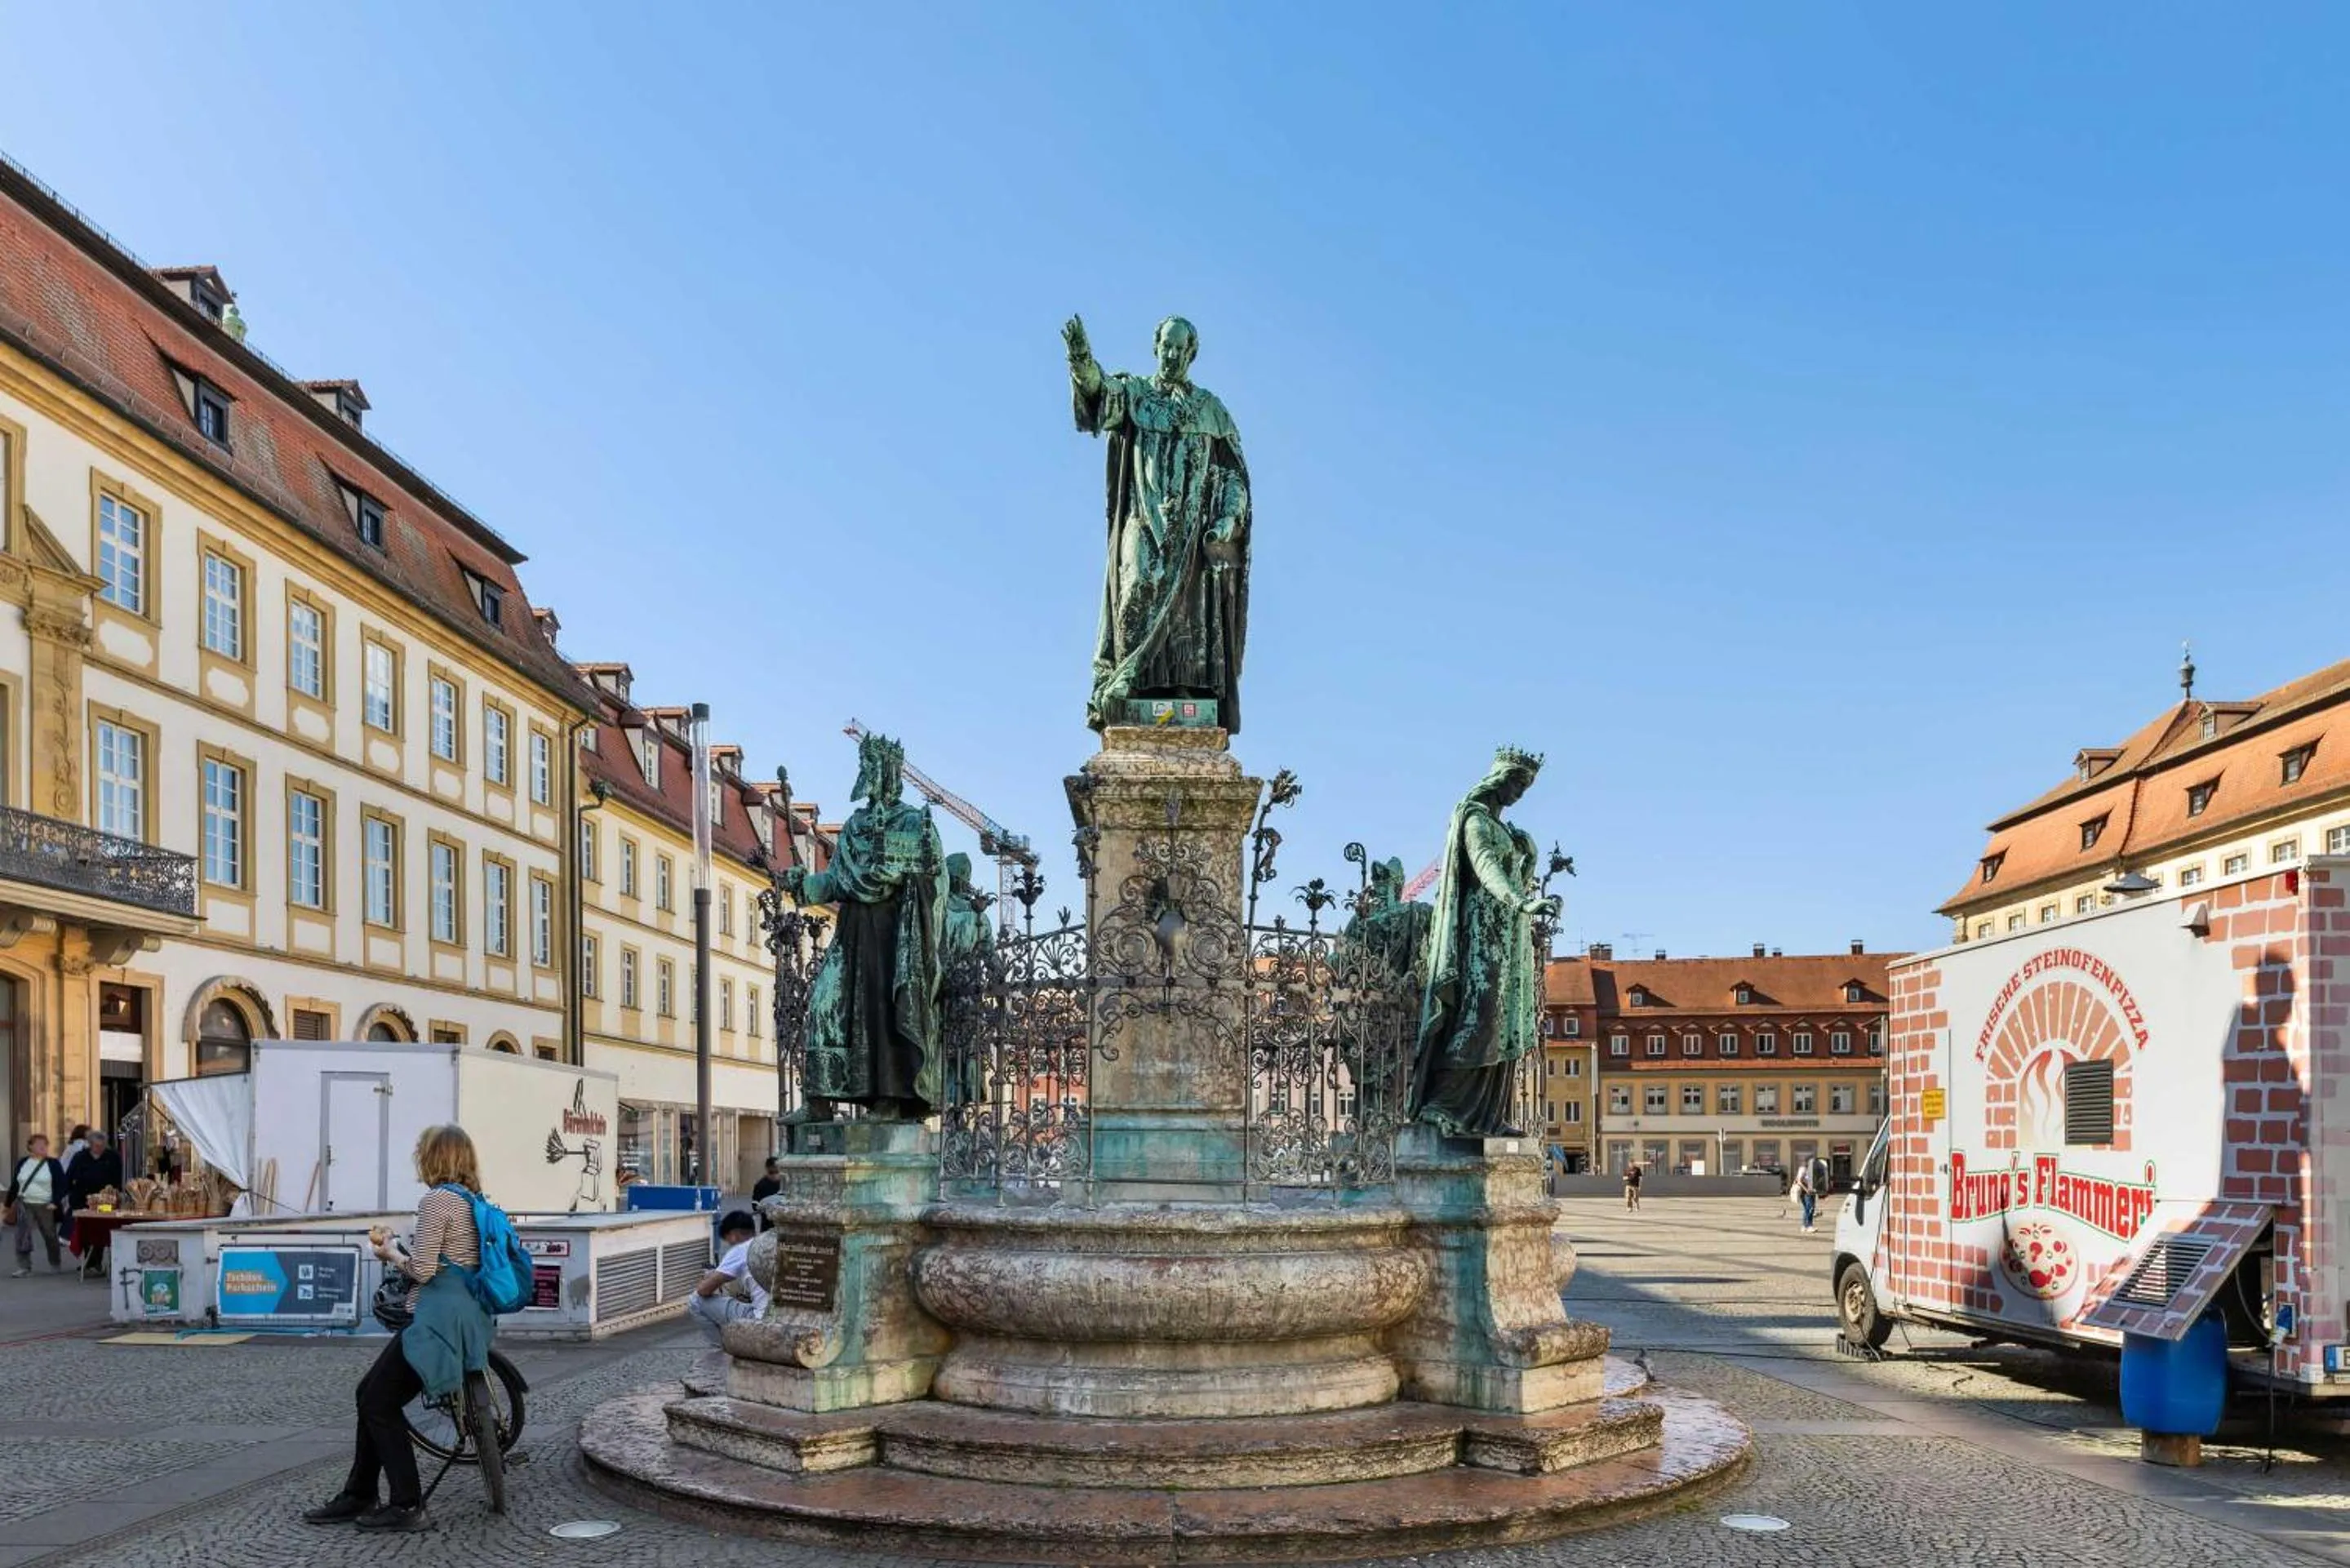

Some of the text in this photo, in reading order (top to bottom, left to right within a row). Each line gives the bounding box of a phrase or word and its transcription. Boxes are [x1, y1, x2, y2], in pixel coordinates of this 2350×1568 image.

[1975, 948, 2150, 1062] FRISCHE STEINOFENPIZZA
[1950, 1152, 2030, 1220] Bruno's
